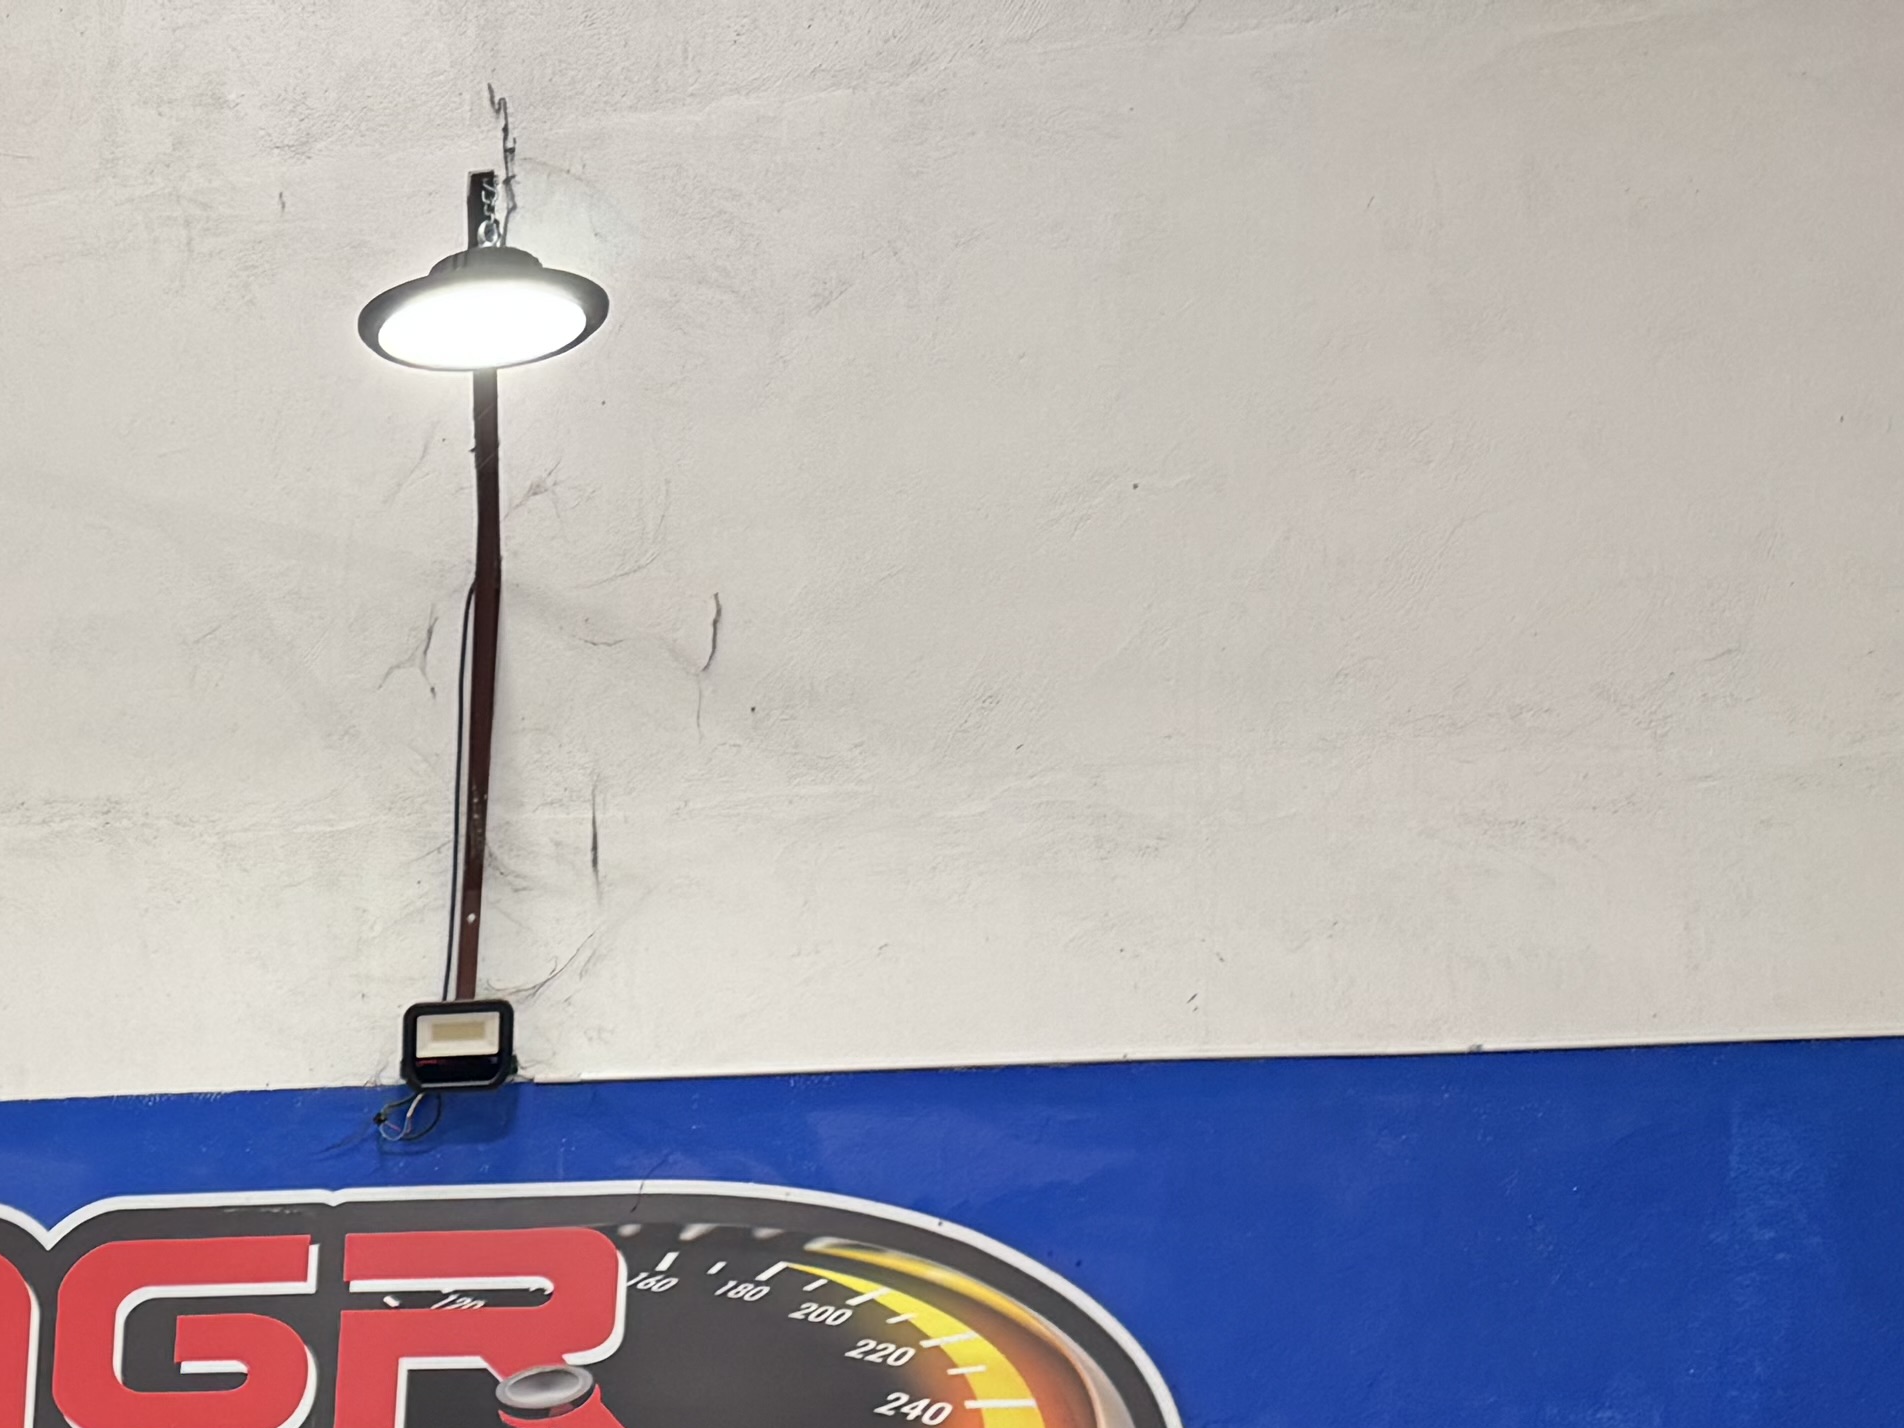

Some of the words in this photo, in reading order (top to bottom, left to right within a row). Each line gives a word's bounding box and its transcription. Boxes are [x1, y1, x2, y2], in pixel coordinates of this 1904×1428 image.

[627, 1272, 679, 1293] 160
[714, 1280, 771, 1302] 180
[788, 1302, 853, 1327] 200
[844, 1339, 916, 1367] 220
[873, 1391, 953, 1427] 240
